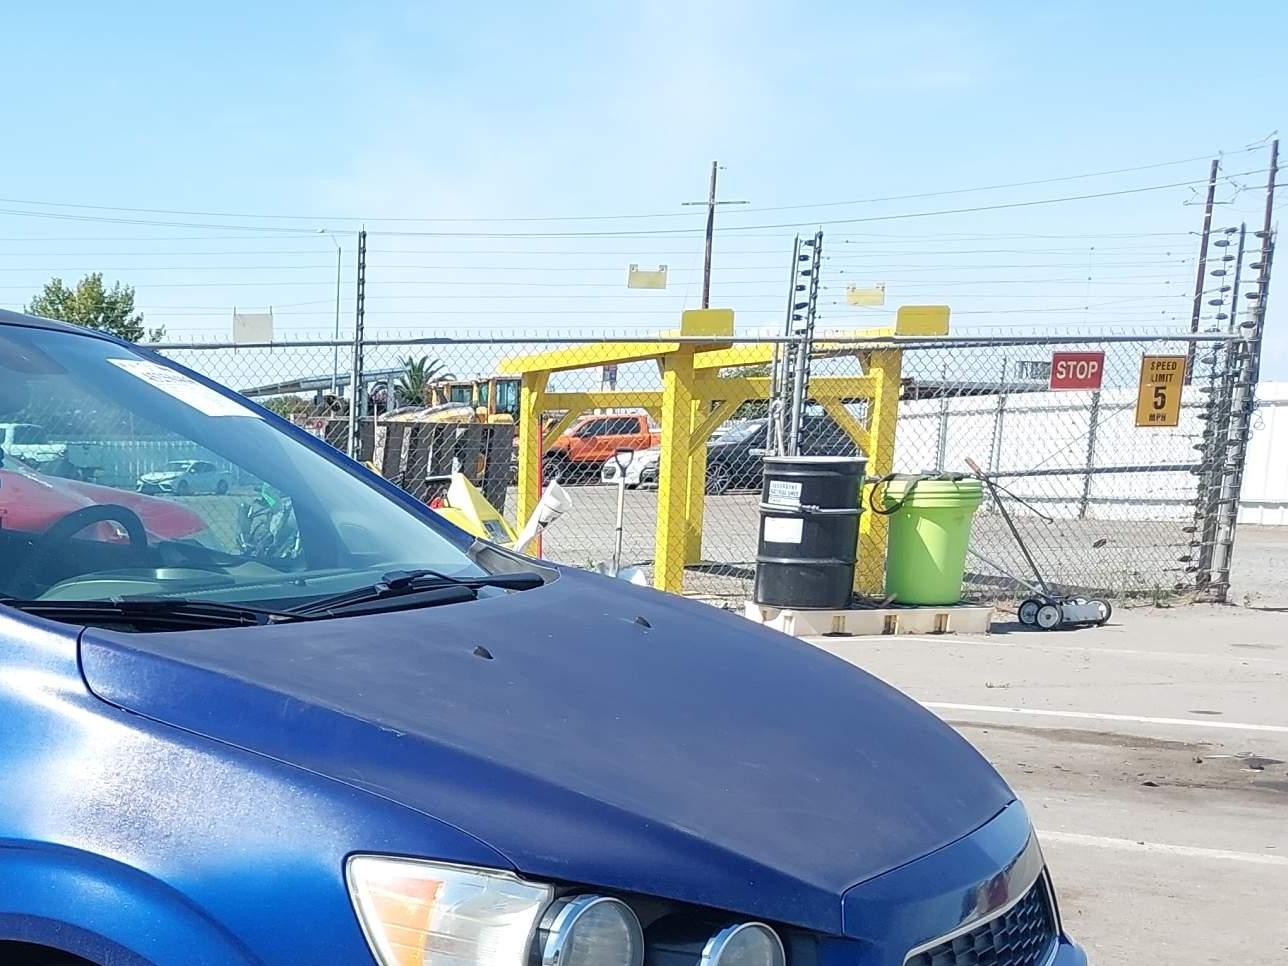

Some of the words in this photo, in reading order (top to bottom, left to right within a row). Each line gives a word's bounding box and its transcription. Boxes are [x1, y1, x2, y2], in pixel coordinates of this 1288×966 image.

[1056, 360, 1099, 380] STOP
[1150, 361, 1178, 371] SPEED
[1151, 373, 1175, 383] LIMIT
[1153, 385, 1167, 410] 5
[1148, 413, 1167, 422] MPH
